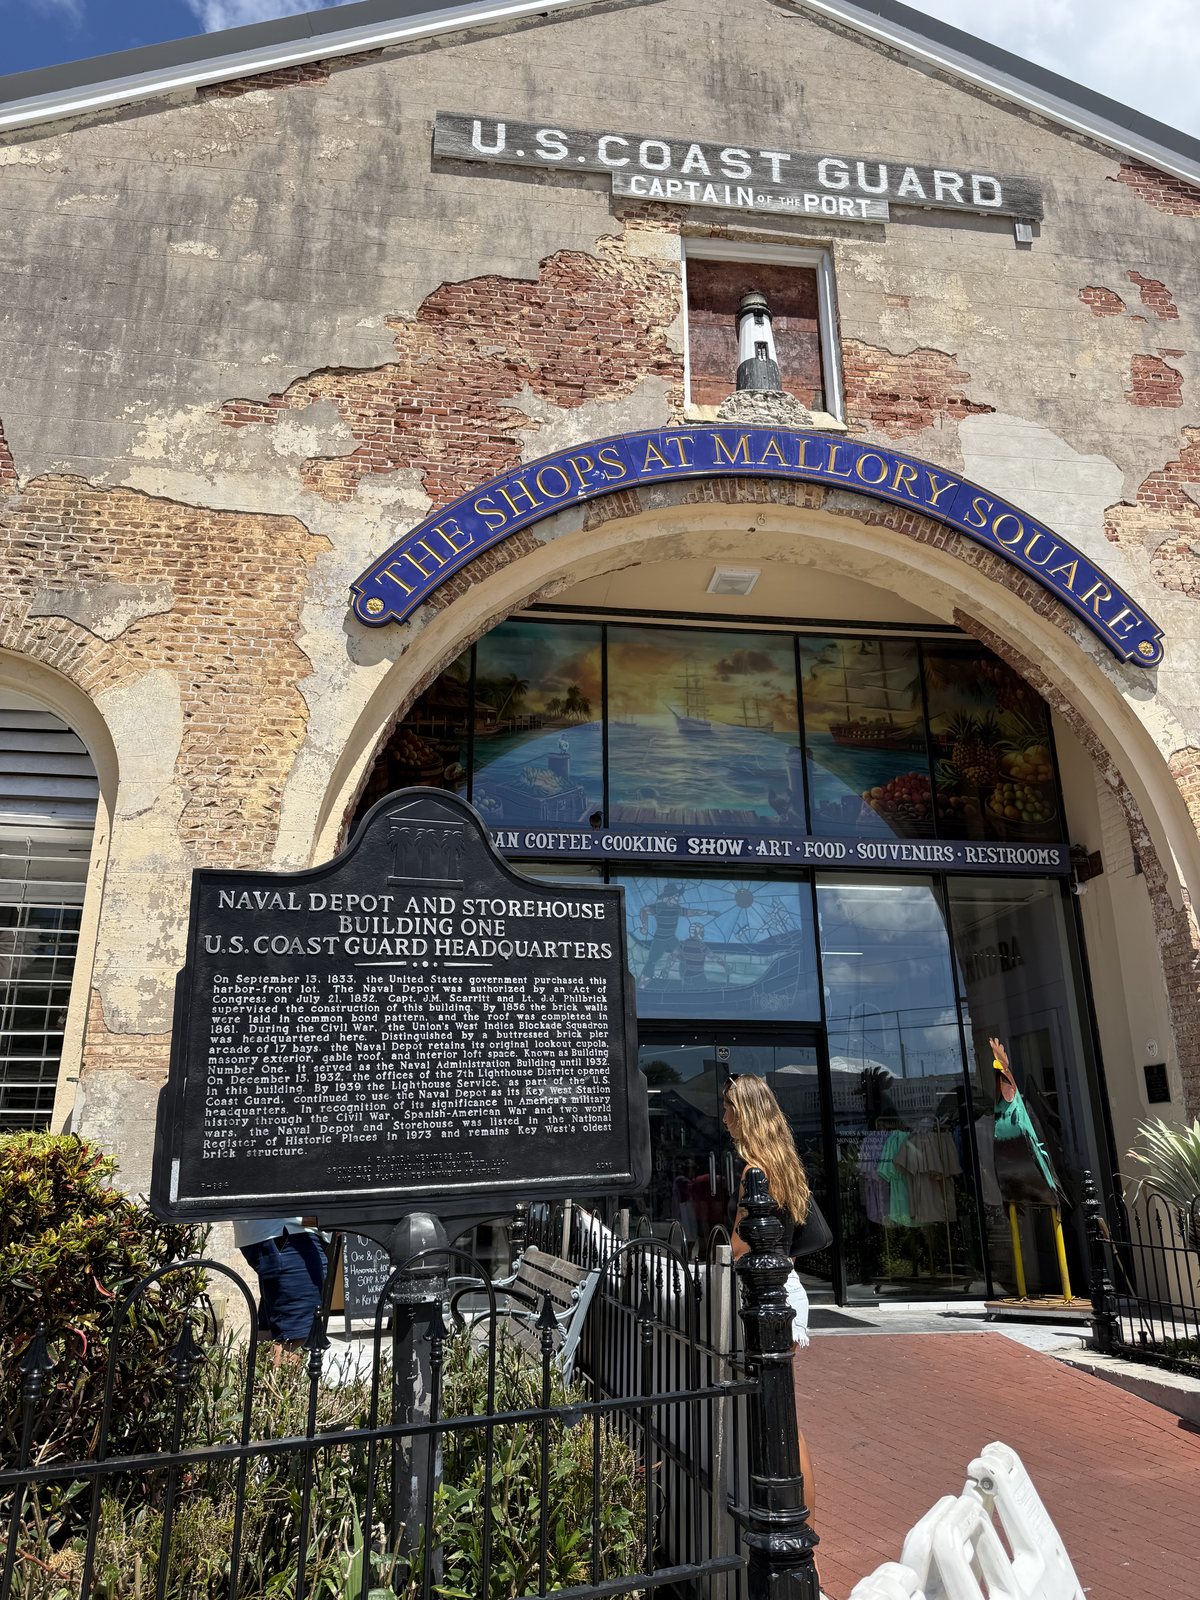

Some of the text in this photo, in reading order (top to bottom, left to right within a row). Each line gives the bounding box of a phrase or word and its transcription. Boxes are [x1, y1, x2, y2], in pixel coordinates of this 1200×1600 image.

[472, 120, 1002, 208] U.S. COAST GUARD
[630, 175, 870, 218] CAPTAIN OF THE PORT
[375, 433, 1143, 640] THE SHOPS AT MALLORY SQUARE
[525, 832, 592, 850] COFFEE
[601, 835, 677, 853] COOKING
[688, 838, 744, 855] SHOW
[756, 840, 792, 856] ART
[804, 841, 846, 859] FOOD
[857, 843, 954, 862] SOUVENIRS
[965, 847, 1060, 865] RESTROOMS
[218, 890, 605, 919] NAVAL DEPOT AND STOREHOUSE
[338, 915, 505, 937] BUILDING ONE
[204, 935, 612, 960] U.S. COAST GUARD HEADQUARTERS
[213, 974, 229, 984] On
[236, 974, 300, 986] September
[365, 974, 384, 983] the
[389, 974, 424, 984] United
[430, 974, 463, 984] States
[469, 975, 527, 986] government
[534, 975, 584, 987] purchased
[589, 975, 607, 985] this
[213, 984, 293, 994] harbor-front
[300, 984, 320, 993] lot.
[333, 984, 354, 993] The
[362, 983, 394, 993] Naval
[402, 983, 434, 995] Depot
[442, 985, 462, 993] was
[470, 983, 525, 993] authorized
[533, 984, 545, 995] by
[572, 984, 590, 993] Act
[597, 984, 607, 993] of
[211, 1002, 608, 1016] supervised the construction of this building. By 1856 the brick walls
[212, 994, 267, 1006] Congress
[296, 994, 321, 1005] July
[350, 993, 378, 1003] 1852.
[388, 993, 416, 1005] Capt.
[423, 993, 442, 1003] J.M.
[449, 993, 490, 1002] Scarritt
[497, 993, 514, 1002] and
[521, 993, 534, 1002] Lt.
[540, 993, 557, 1002] J.J.
[563, 993, 607, 1002] Philbrick
[248, 1013, 271, 1023] laid
[279, 1013, 290, 1022] in
[350, 1012, 378, 1022] bond
[438, 1012, 457, 1021] and
[463, 1012, 480, 1021] the
[487, 1012, 509, 1021] roof
[541, 1011, 592, 1023] completed
[598, 1011, 608, 1020] in
[210, 1024, 238, 1033] 1861.
[249, 1023, 289, 1035] During
[295, 1022, 314, 1032] the
[320, 1022, 348, 1032] Civil
[387, 1021, 405, 1031] the
[412, 1021, 449, 1030] Union's
[455, 1021, 479, 1030] West
[484, 1020, 514, 1030] Indies
[519, 1020, 562, 1030] Blockade
[566, 1020, 609, 1032] Squadron
[210, 1036, 232, 1044] was
[242, 1032, 330, 1045] headquartered
[339, 1031, 367, 1041] here.
[381, 1030, 453, 1043] Distinguished
[461, 1030, 474, 1042] by
[496, 1030, 549, 1039] buttressed
[556, 1029, 582, 1039] brick
[589, 1029, 609, 1041] pier
[203, 1122, 612, 1151] Register of Historic Places in 1973 and remains Key West's oldest
[202, 1146, 308, 1159] brick structure.
